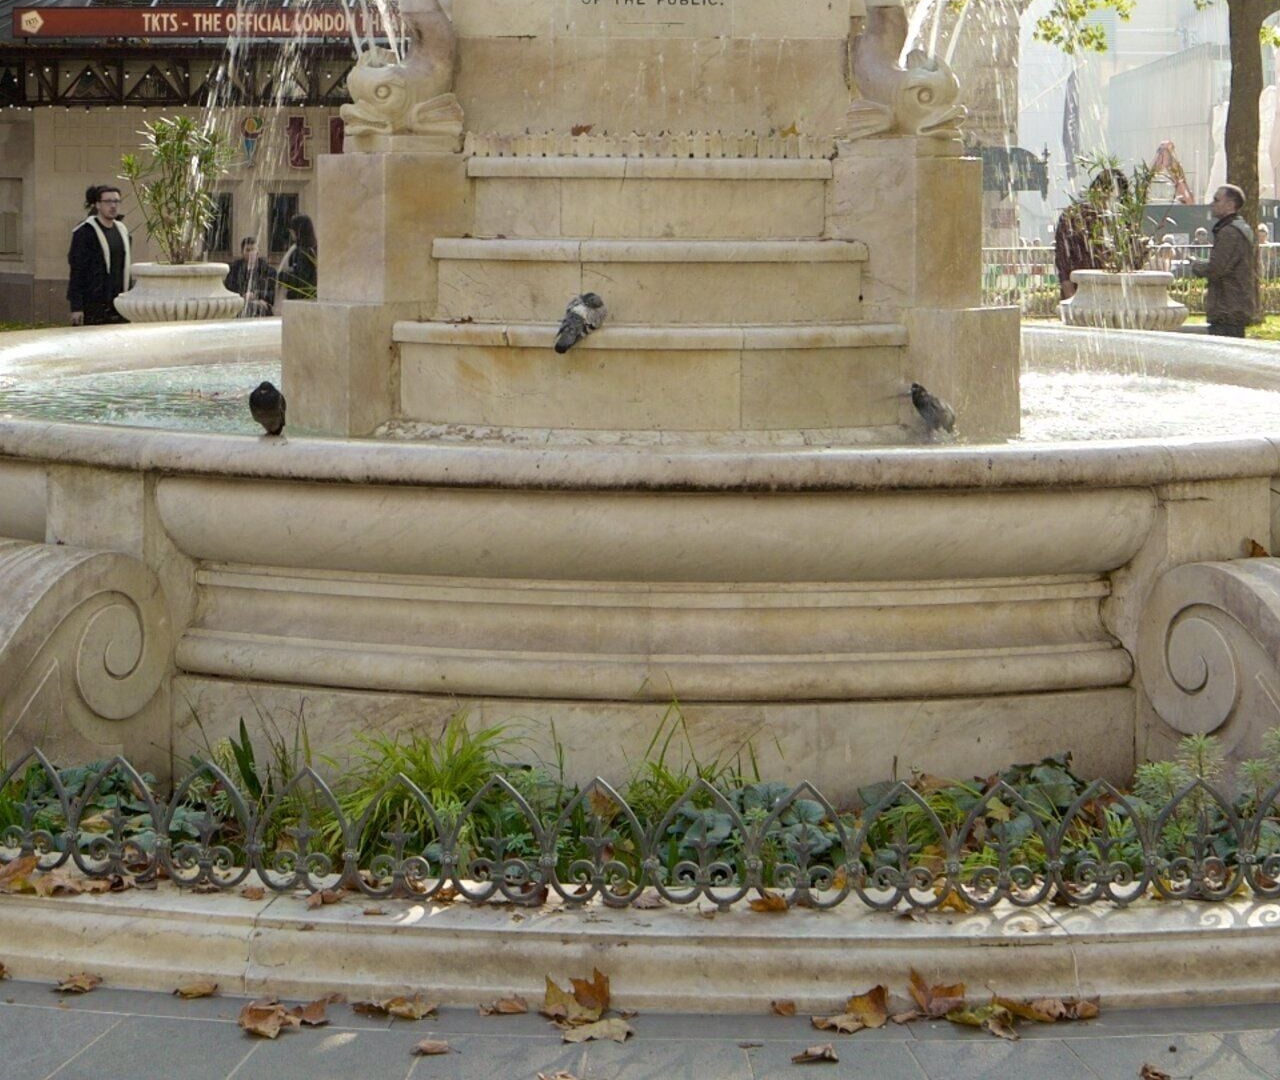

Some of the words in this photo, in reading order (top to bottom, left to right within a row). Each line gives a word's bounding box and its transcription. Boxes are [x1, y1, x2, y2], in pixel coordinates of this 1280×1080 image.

[142, 13, 178, 32] TKTS
[193, 13, 222, 32] THE
[225, 13, 290, 32] OFFICIAL
[293, 13, 354, 32] LONDON
